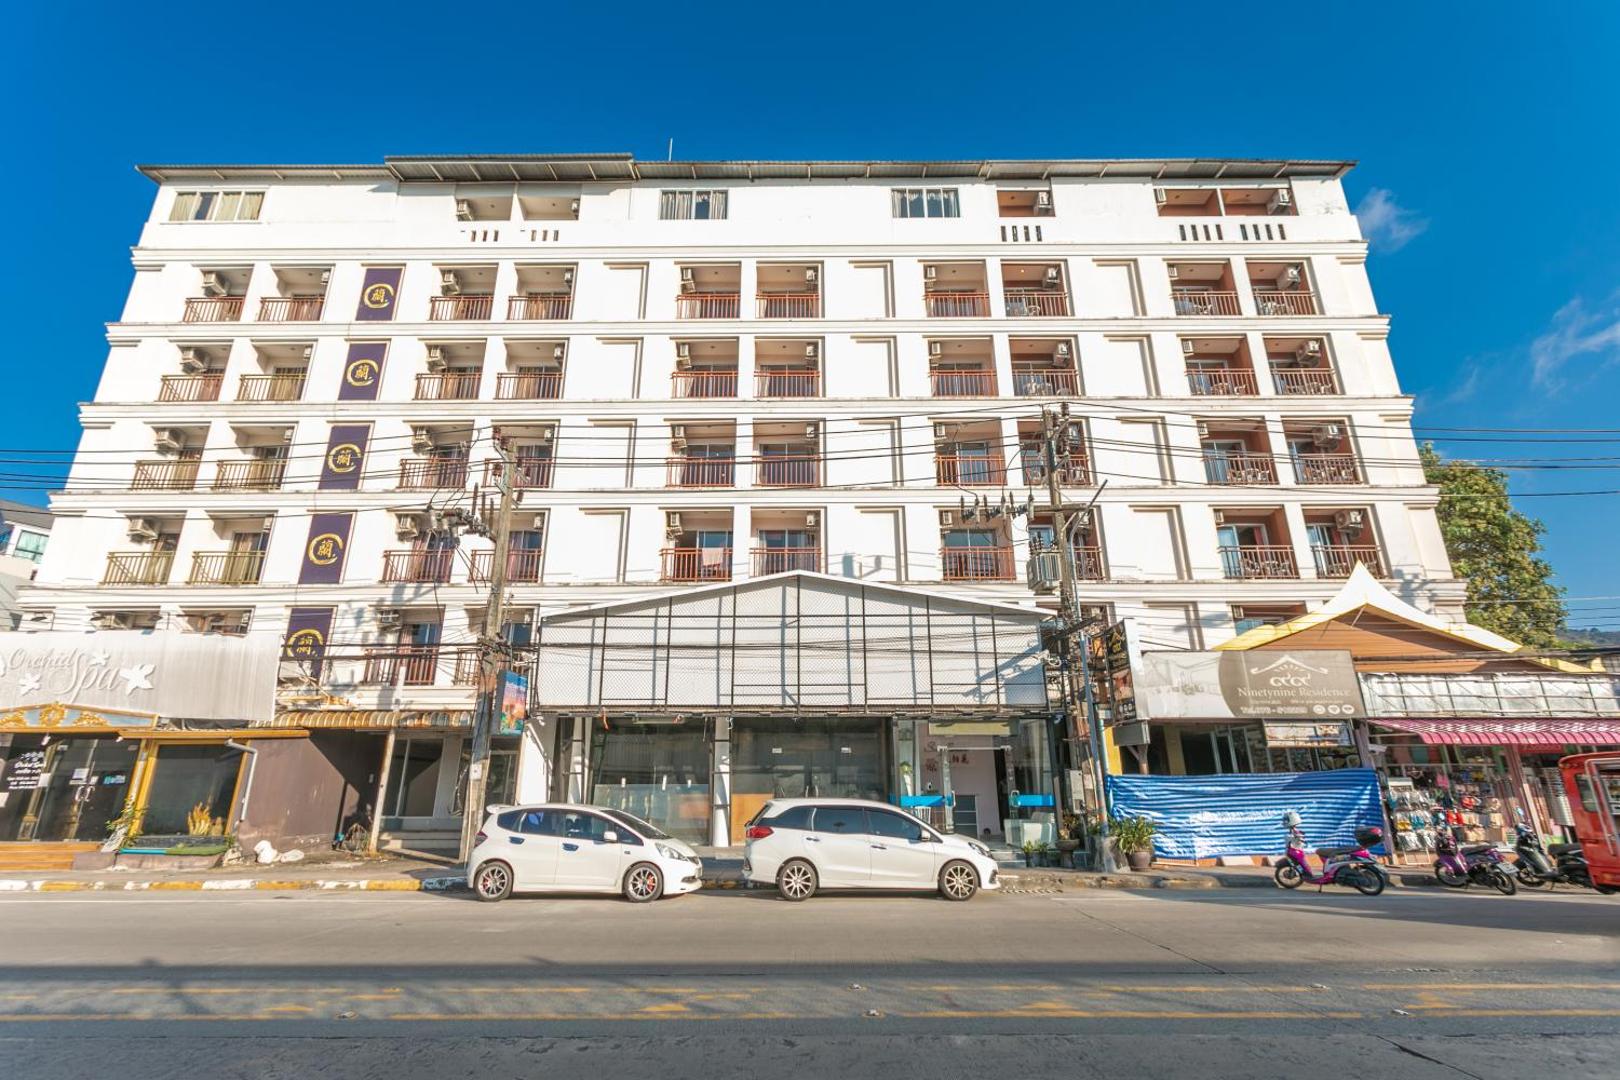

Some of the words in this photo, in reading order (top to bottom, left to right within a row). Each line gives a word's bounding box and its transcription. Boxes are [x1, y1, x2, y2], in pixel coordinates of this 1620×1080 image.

[8, 647, 76, 670] Orchid
[47, 652, 121, 703] Spa
[1238, 687, 1297, 699] Ninetynine
[1299, 687, 1352, 697] Residence
